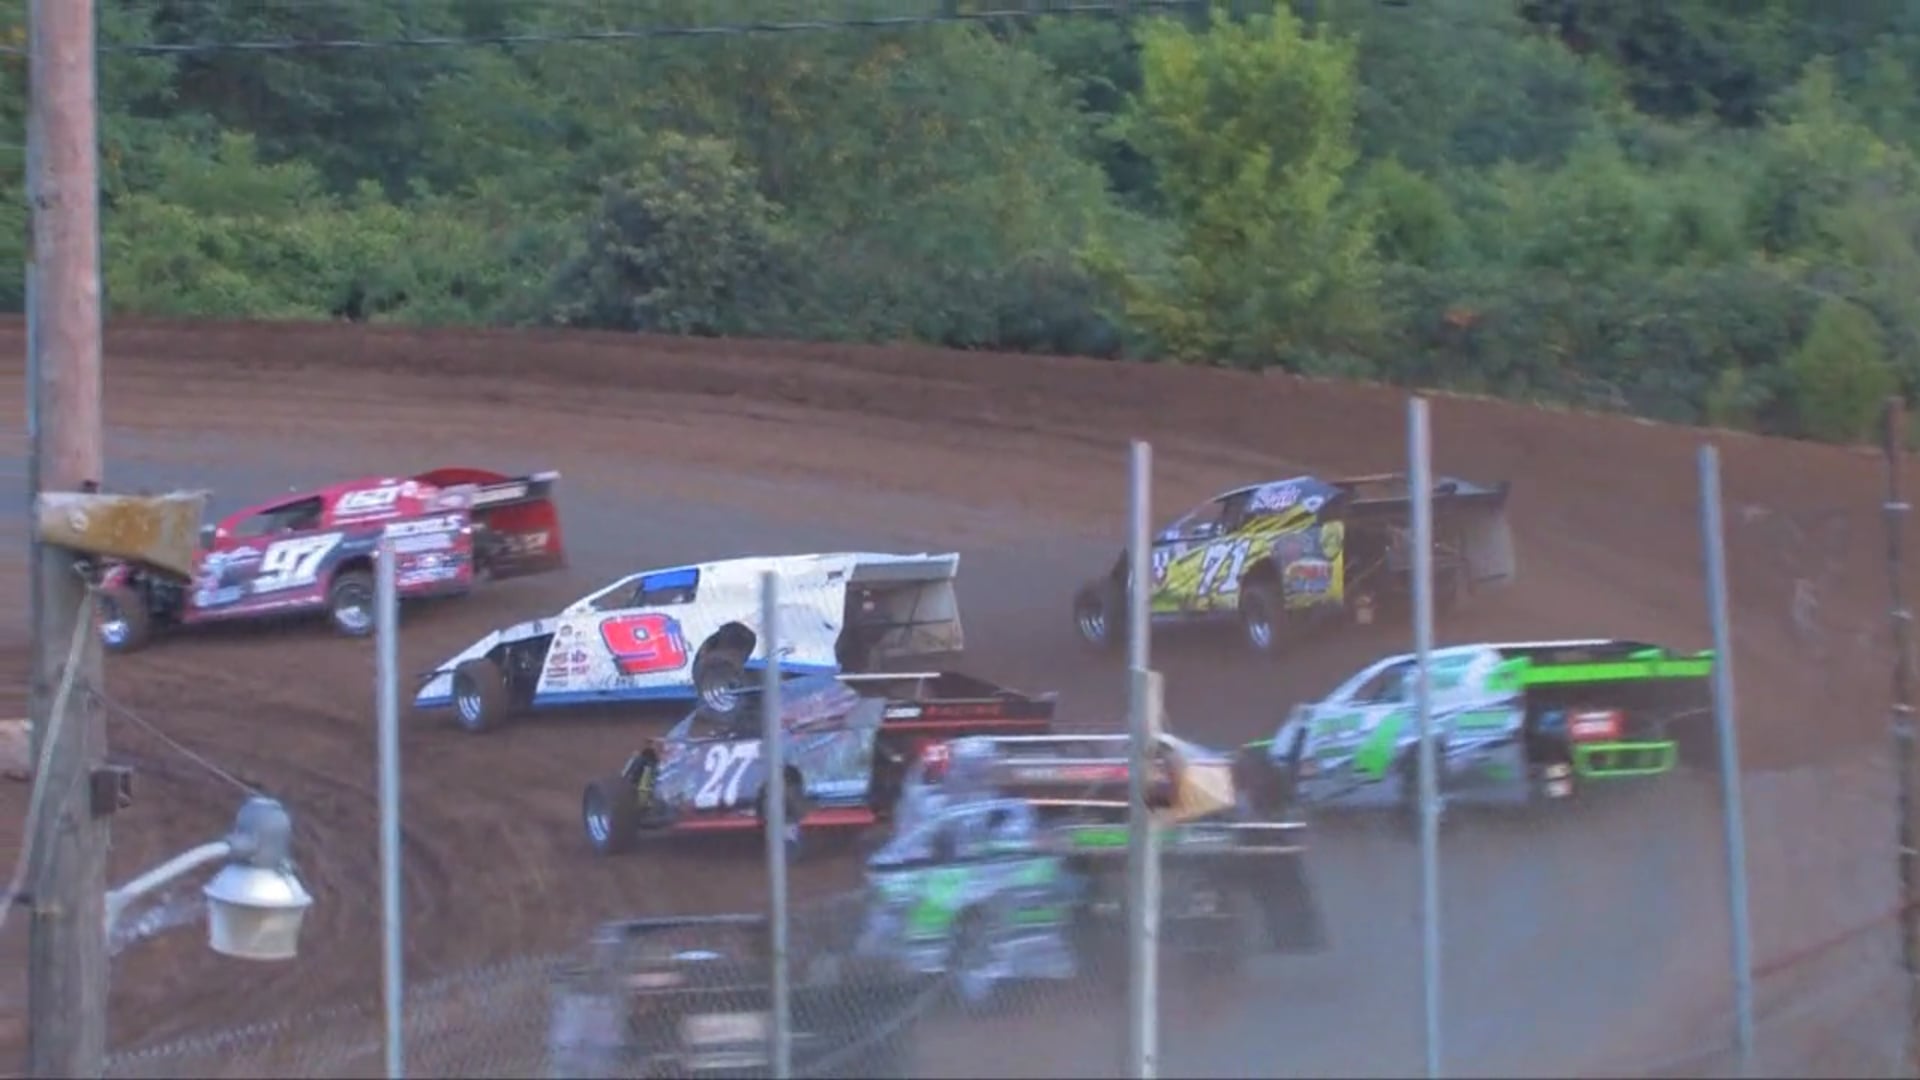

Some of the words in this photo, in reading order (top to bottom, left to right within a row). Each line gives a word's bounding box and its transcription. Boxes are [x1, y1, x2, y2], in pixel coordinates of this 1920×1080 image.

[252, 533, 344, 593] 97
[1198, 538, 1250, 596] 71
[695, 740, 763, 808] 27
